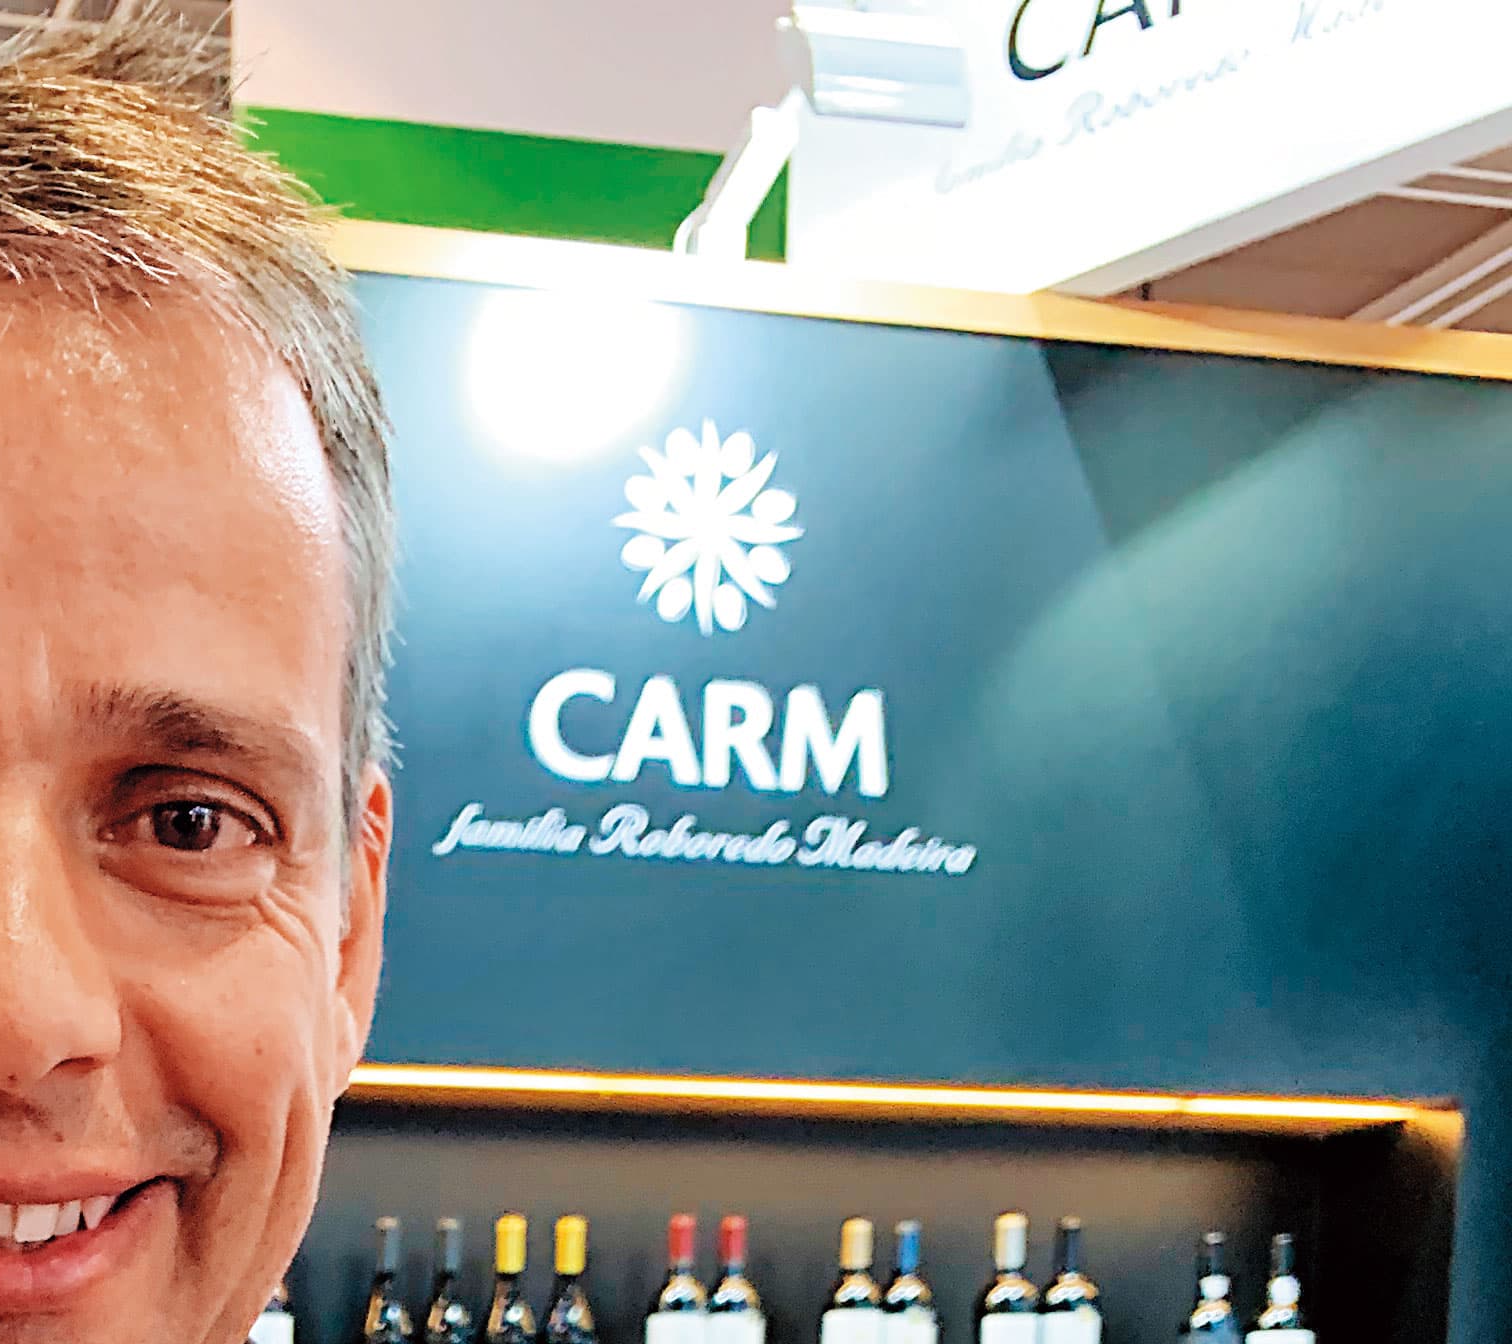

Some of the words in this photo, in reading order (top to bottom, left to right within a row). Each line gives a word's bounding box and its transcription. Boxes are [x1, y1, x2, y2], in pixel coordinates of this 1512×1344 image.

[528, 668, 889, 798] CARM
[432, 802, 588, 854] familia
[588, 803, 798, 864] Roboredo
[796, 815, 978, 875] Madeira
